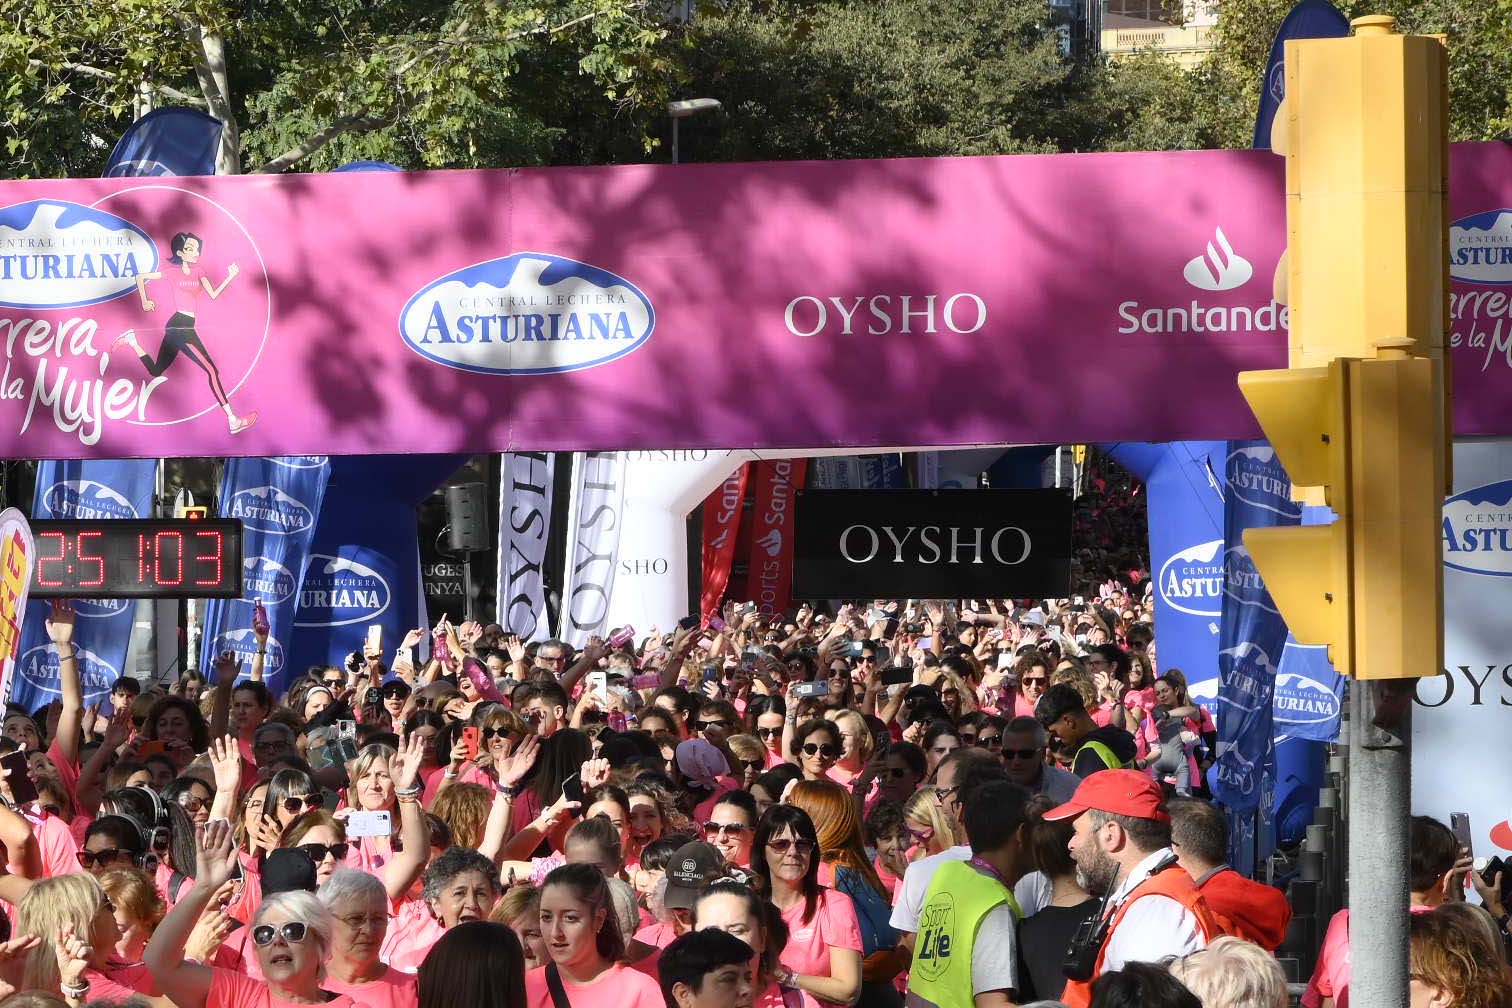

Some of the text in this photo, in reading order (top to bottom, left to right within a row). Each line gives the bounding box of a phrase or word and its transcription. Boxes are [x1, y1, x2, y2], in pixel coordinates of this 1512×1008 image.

[458, 293, 627, 308] CENTRAL LECHERA
[784, 293, 988, 337] OYSHO
[1117, 300, 1289, 335] Santande
[419, 300, 635, 344] ASTURIANA
[1467, 320, 1486, 348] la
[0, 358, 25, 400] la
[19, 352, 169, 446] Mujer
[838, 523, 1033, 566] OYSHO
[619, 557, 669, 576] SHO
[300, 589, 381, 609] URIANA
[759, 560, 780, 621] ports
[918, 926, 951, 968] Life
